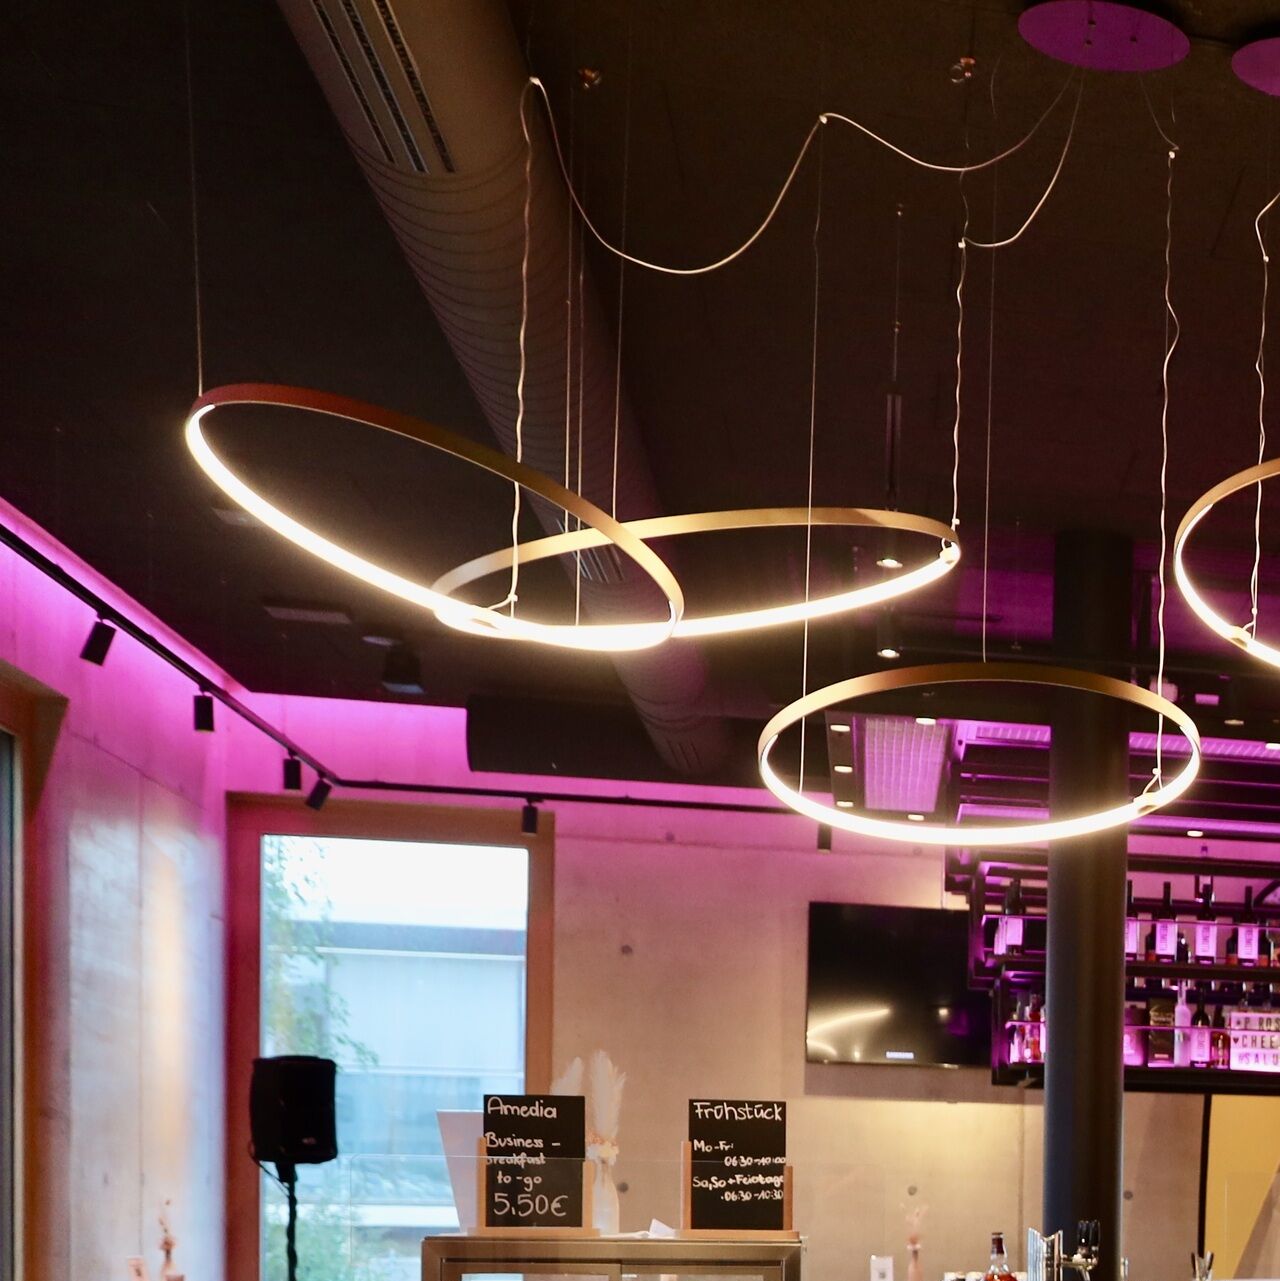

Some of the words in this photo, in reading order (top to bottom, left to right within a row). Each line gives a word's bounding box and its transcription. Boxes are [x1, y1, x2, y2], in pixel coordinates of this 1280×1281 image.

[487, 1096, 557, 1118] Amedia
[484, 1131, 544, 1148] Business
[493, 1193, 569, 1217] 5,50€
